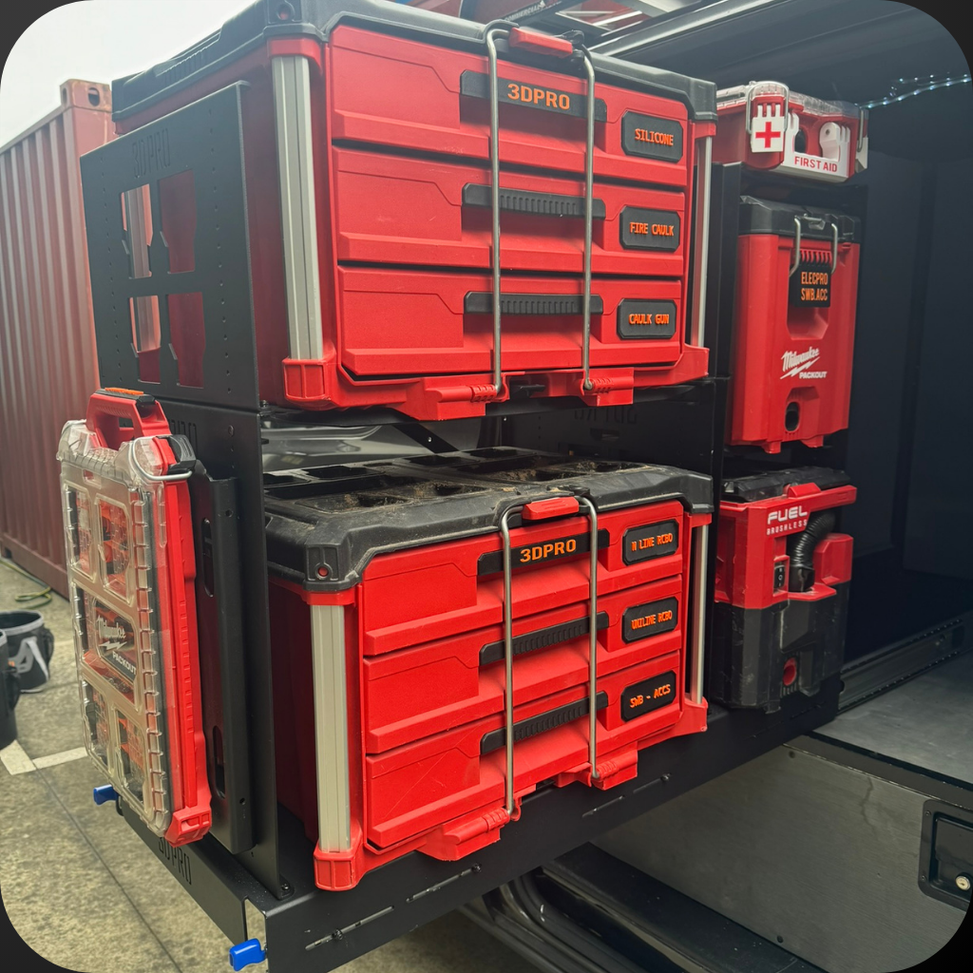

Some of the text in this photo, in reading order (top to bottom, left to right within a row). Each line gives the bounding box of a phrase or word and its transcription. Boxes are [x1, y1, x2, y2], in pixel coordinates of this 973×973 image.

[507, 83, 570, 110] 3DPRO
[634, 128, 674, 147] SILICONE
[794, 156, 838, 173] FIRST AID
[629, 221, 675, 237] FIRE CAULK
[801, 271, 829, 286] ELECPRO
[801, 288, 828, 302] SWB.ACC
[628, 313, 670, 325] CAULK GUN
[781, 346, 820, 372] Milwaukee
[799, 371, 828, 380] PACKOUT
[767, 505, 808, 525] FUEL
[766, 519, 808, 536] BRUSHLESS
[639, 536, 655, 550] LINE
[656, 533, 674, 546] RCBO
[519, 539, 577, 563] 3DPRO
[653, 684, 671, 699] ACCS
